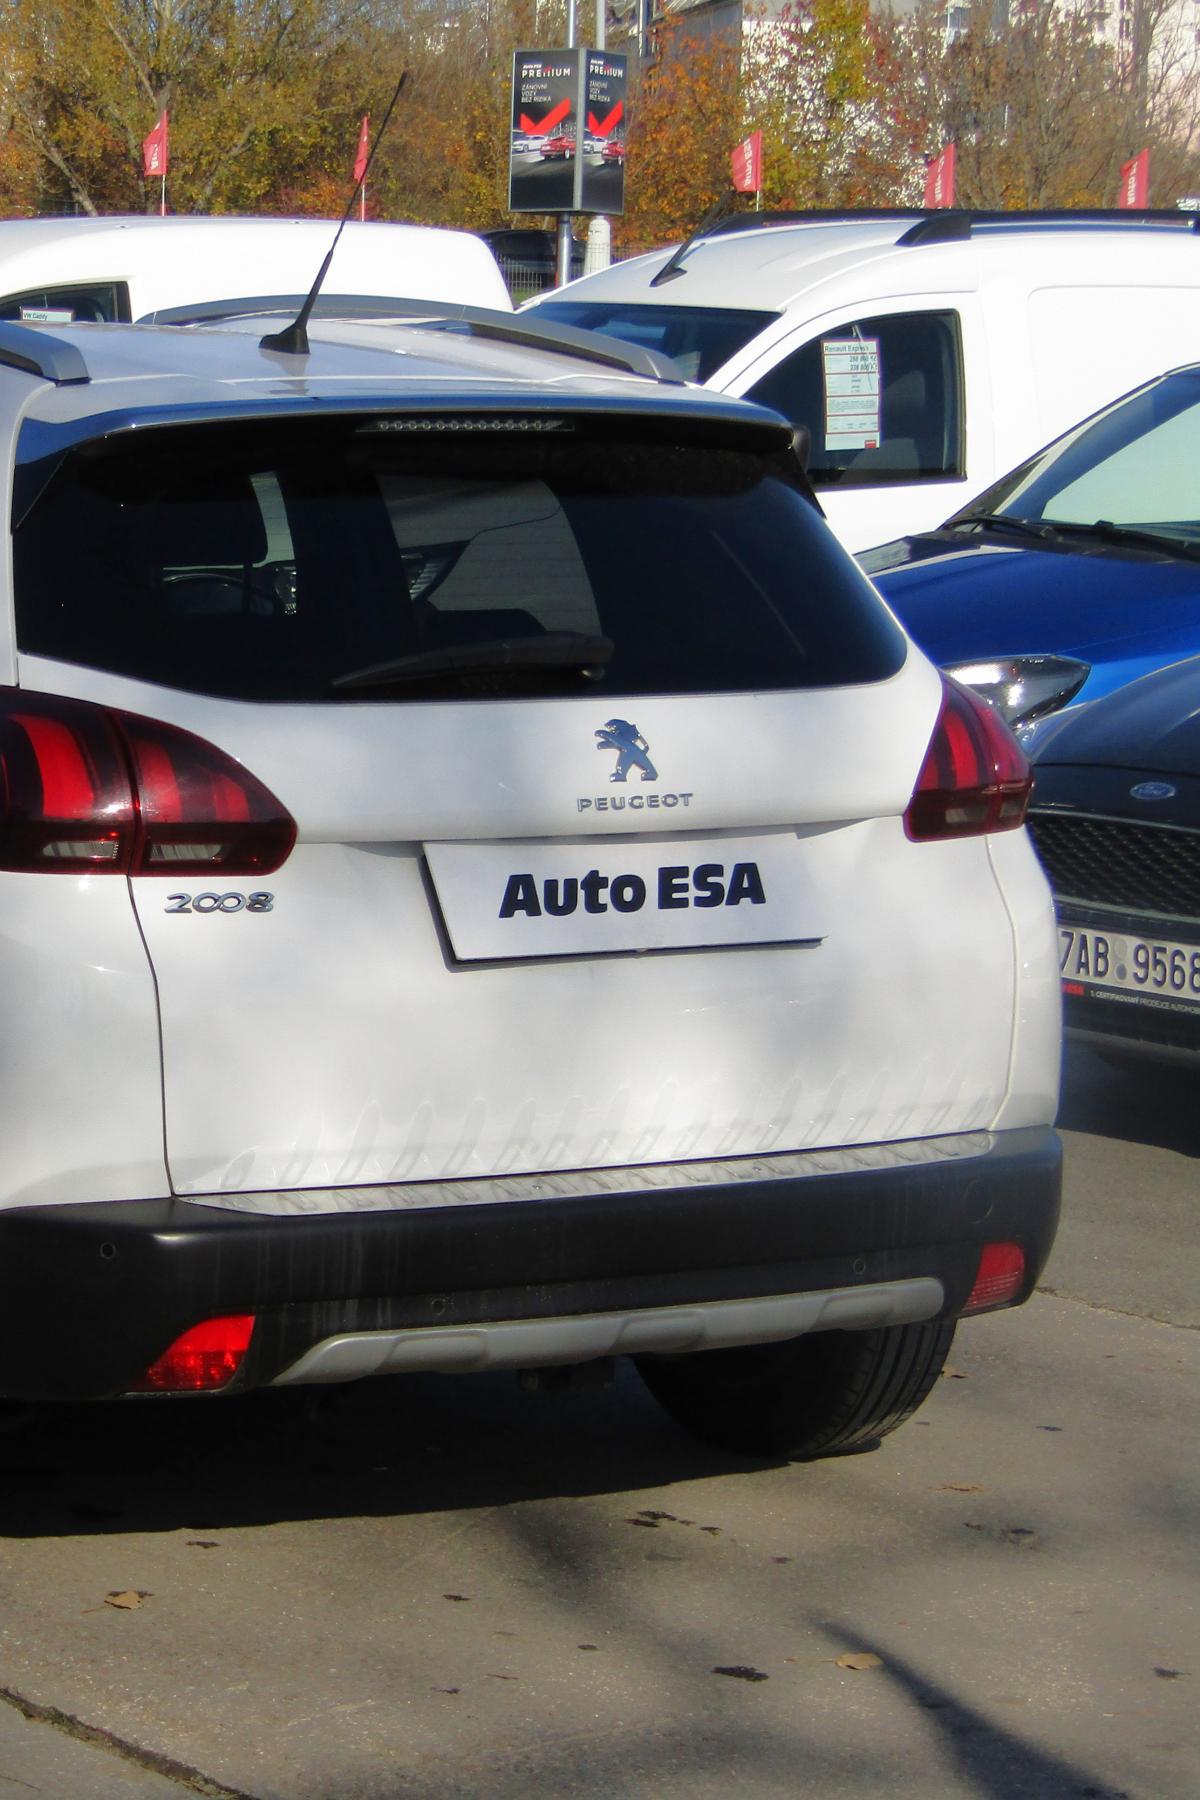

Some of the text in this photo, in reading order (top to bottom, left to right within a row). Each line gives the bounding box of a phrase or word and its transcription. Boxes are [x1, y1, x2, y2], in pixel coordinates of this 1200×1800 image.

[577, 792, 693, 813] PEUGEOT
[164, 891, 275, 914] 2008
[498, 862, 767, 918] Auto ESA
[1060, 930, 1200, 994] 7AB 9568
